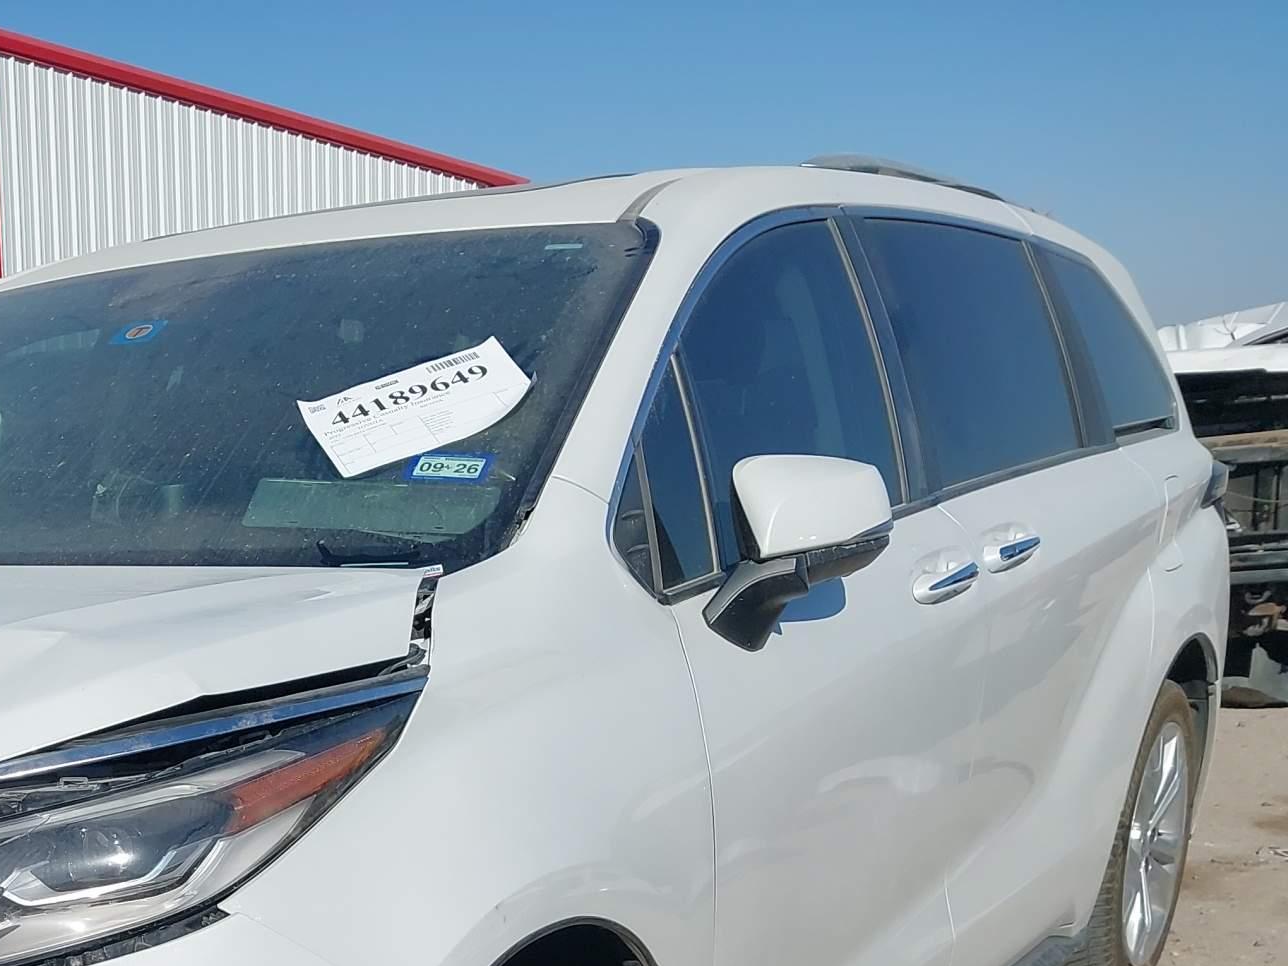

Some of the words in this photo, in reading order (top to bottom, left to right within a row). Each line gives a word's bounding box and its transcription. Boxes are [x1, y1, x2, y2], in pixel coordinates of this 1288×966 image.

[331, 365, 488, 426] 44189649
[419, 462, 444, 473] 09
[454, 463, 480, 474] 26
